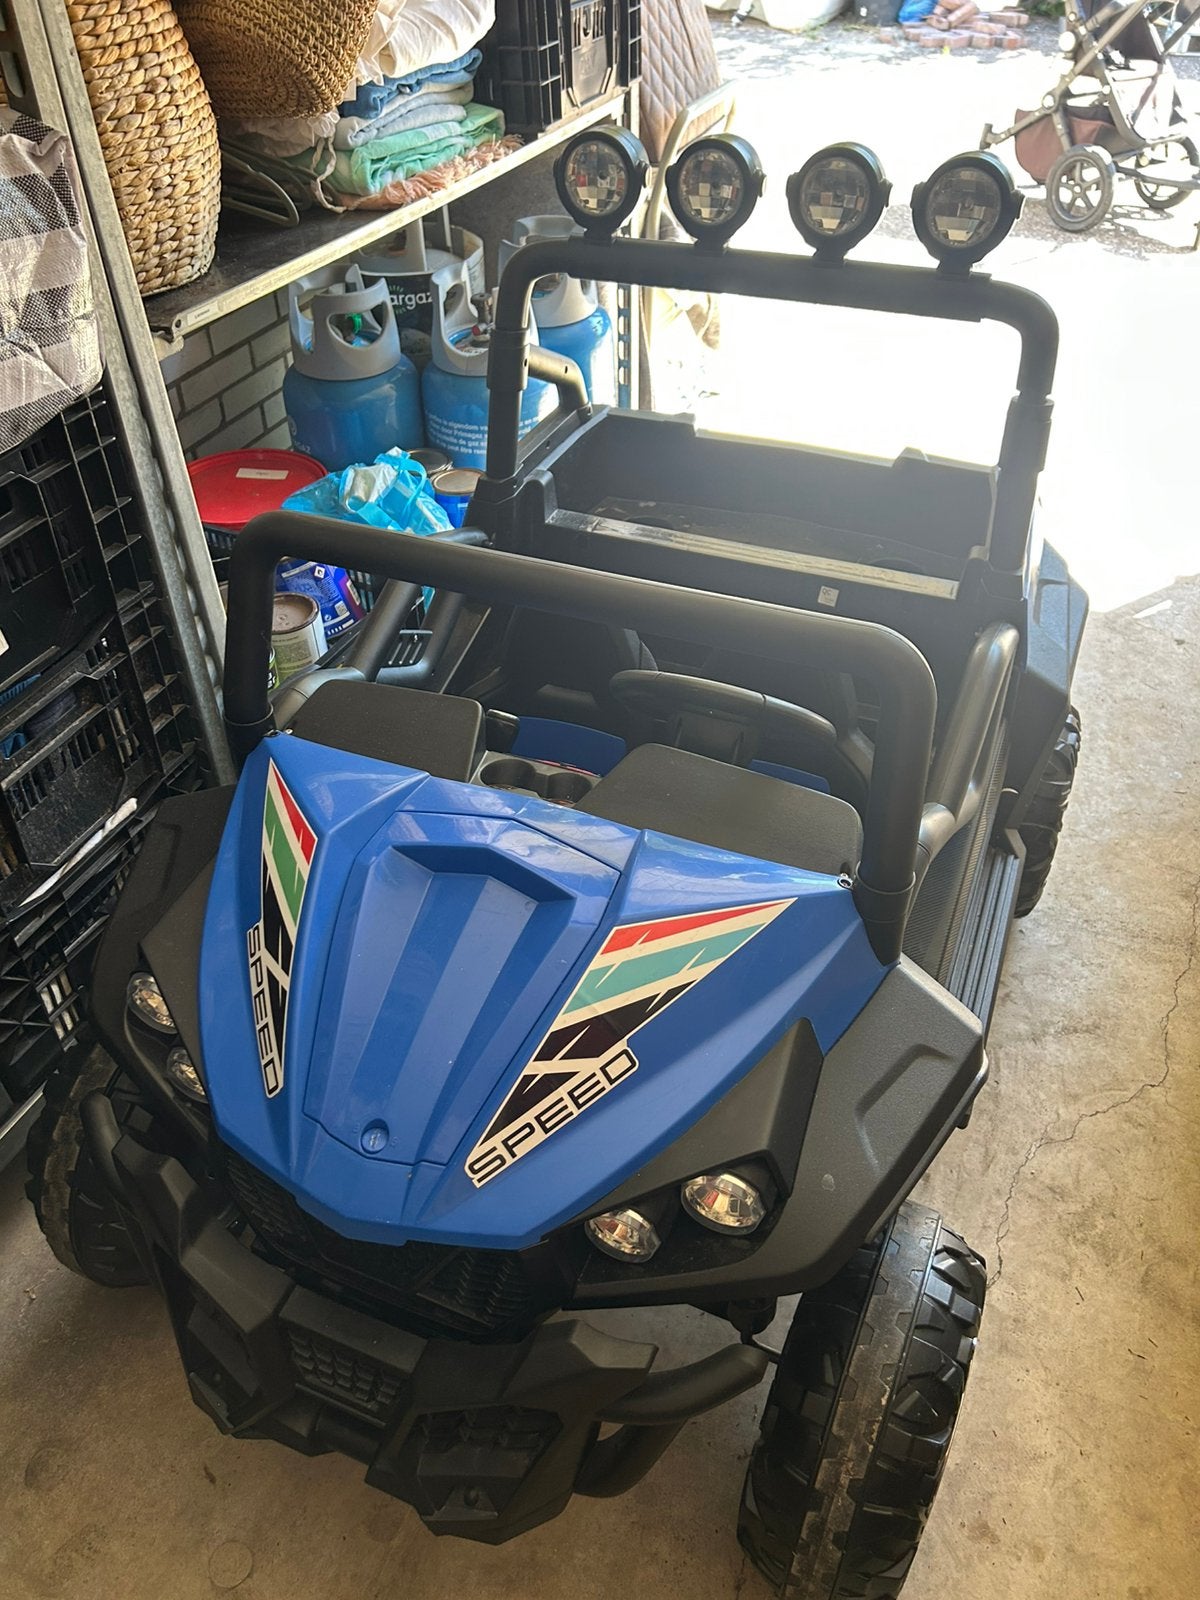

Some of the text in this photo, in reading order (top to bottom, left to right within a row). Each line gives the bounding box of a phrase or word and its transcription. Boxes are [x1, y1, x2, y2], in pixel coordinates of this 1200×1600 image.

[390, 291, 433, 310] argaz
[250, 922, 279, 1096] SPEED
[468, 1048, 637, 1184] SPEED
